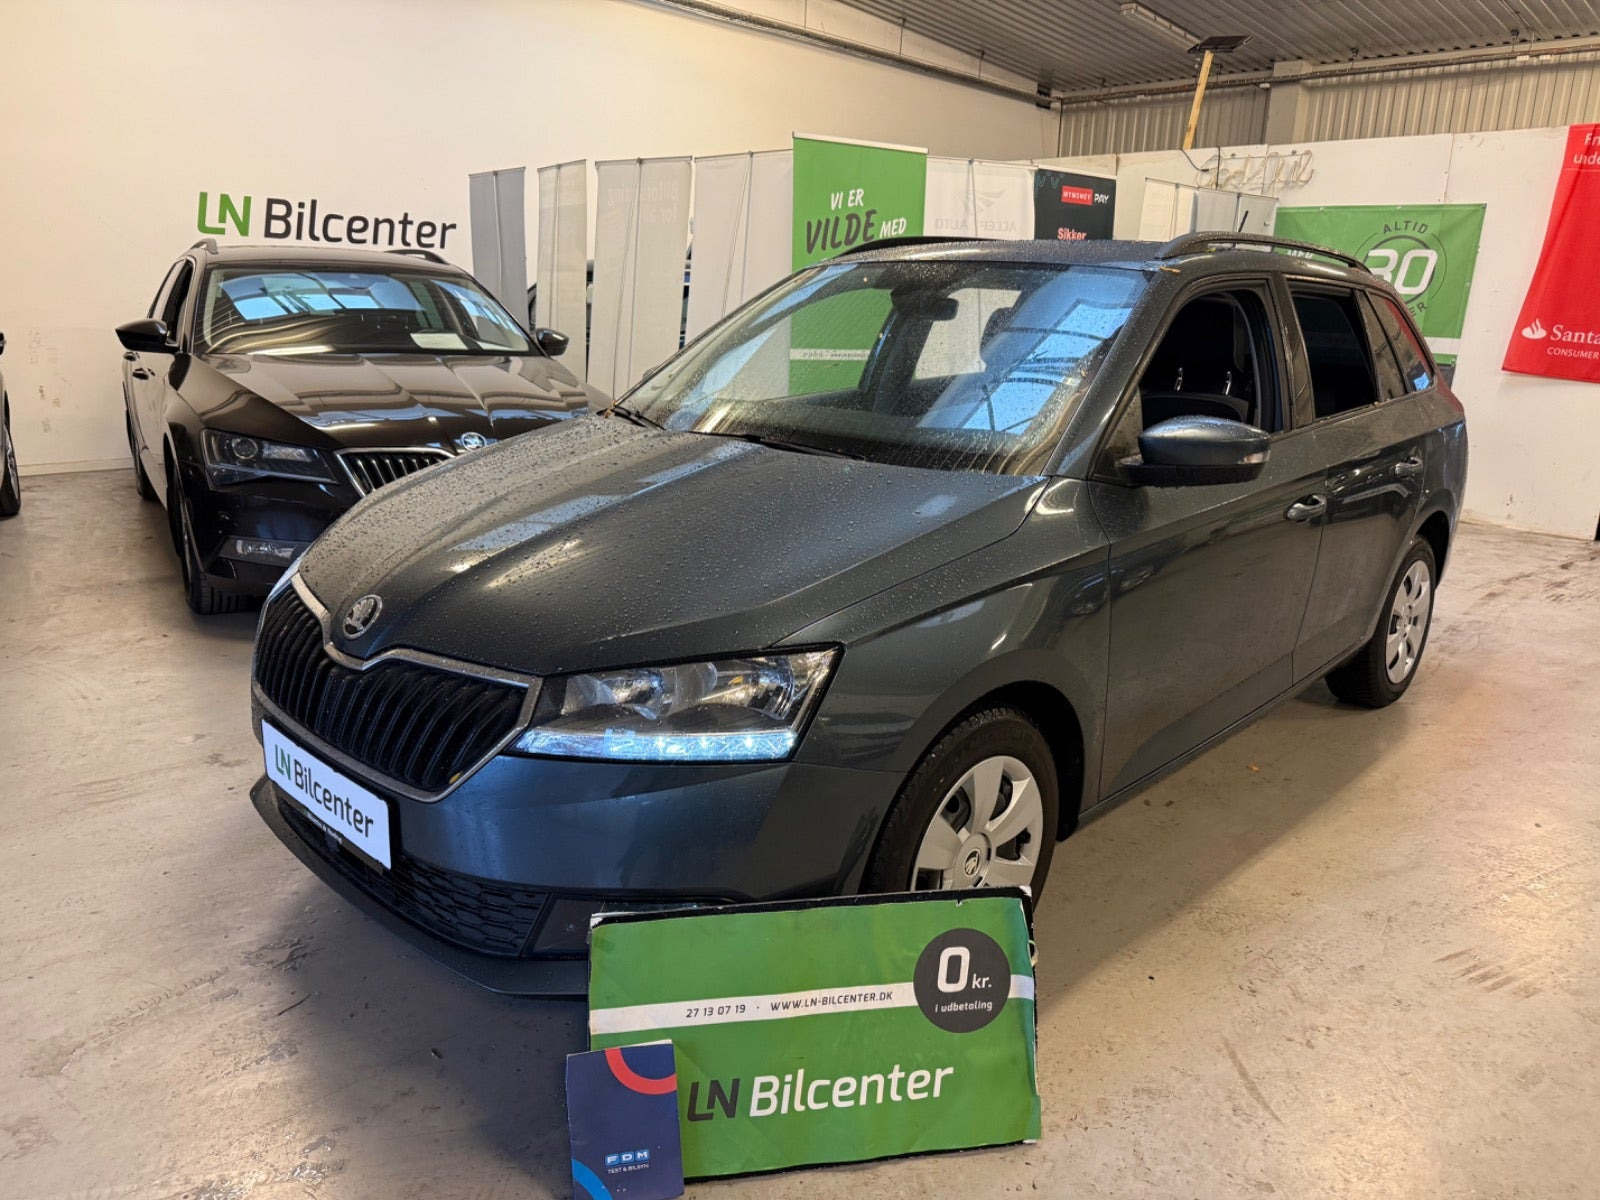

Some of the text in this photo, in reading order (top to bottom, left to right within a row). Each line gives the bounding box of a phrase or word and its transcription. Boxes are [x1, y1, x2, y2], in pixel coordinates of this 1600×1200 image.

[830, 188, 864, 211] VI ER
[1094, 193, 1109, 204] PAY
[197, 191, 457, 249] LN Bilcenter
[1383, 220, 1428, 235] ALTID
[806, 209, 907, 255] VILDE MED
[1057, 227, 1087, 241] Sikker
[1550, 324, 1600, 345] Santa
[1547, 346, 1600, 360] CONSUMER
[275, 744, 291, 781] LN
[294, 758, 374, 838] Bilcenter
[937, 946, 992, 993] 0 kr.
[685, 991, 893, 1018] 27 13 07 19 WWW.LN-BILCENTER.DK
[934, 1000, 993, 1013] i udbetaling
[687, 1064, 954, 1122] LN Bilcenter
[607, 1151, 648, 1164] FDM
